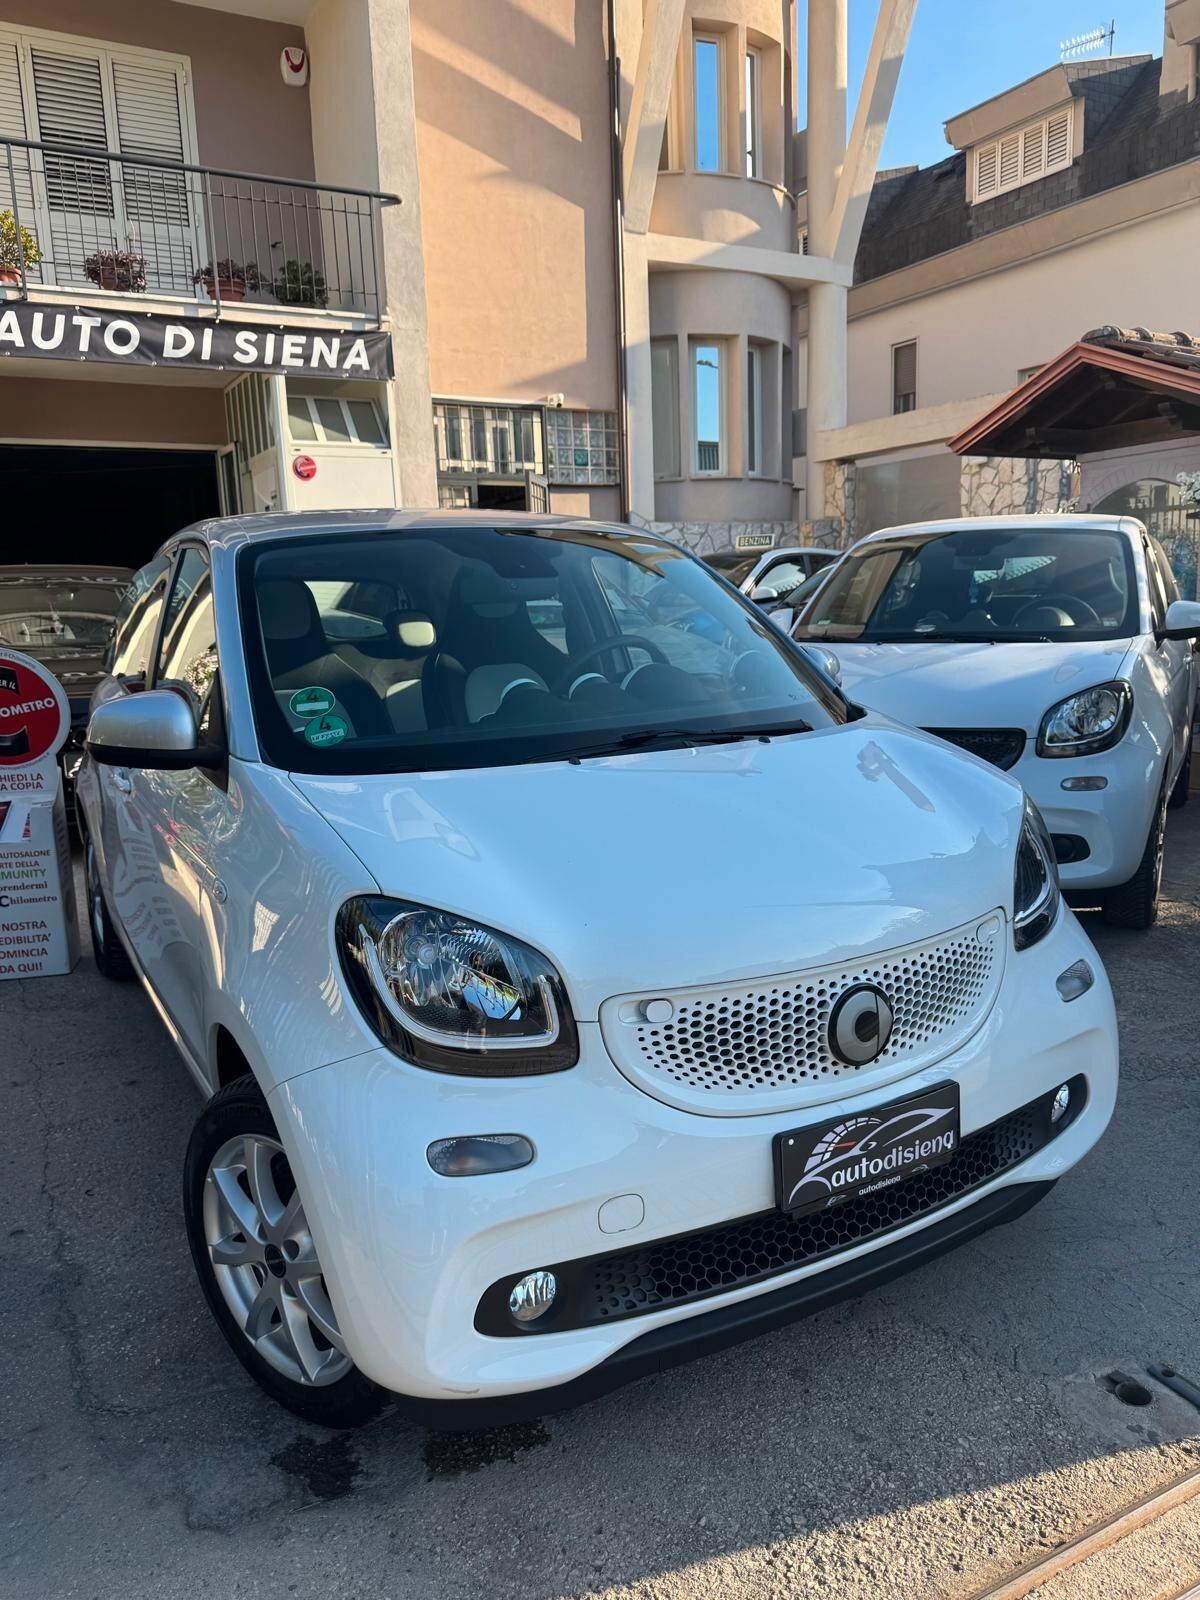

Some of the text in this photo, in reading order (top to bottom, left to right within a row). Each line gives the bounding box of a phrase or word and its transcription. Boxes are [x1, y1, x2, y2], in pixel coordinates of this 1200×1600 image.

[0, 311, 371, 371] AUTO DI SIENA
[740, 537, 770, 546] BENZINA
[0, 697, 55, 718] OMETRO
[31, 772, 44, 782] LA
[10, 781, 43, 791] COPIA
[15, 860, 40, 868] DELLA
[1, 868, 47, 880] MUNITY
[1, 920, 47, 931] NOSTRA
[0, 947, 48, 960] OMINCIA
[0, 962, 43, 974] DA QUI!
[831, 1129, 955, 1188] autodisiena
[858, 1175, 901, 1196] autodisiena
